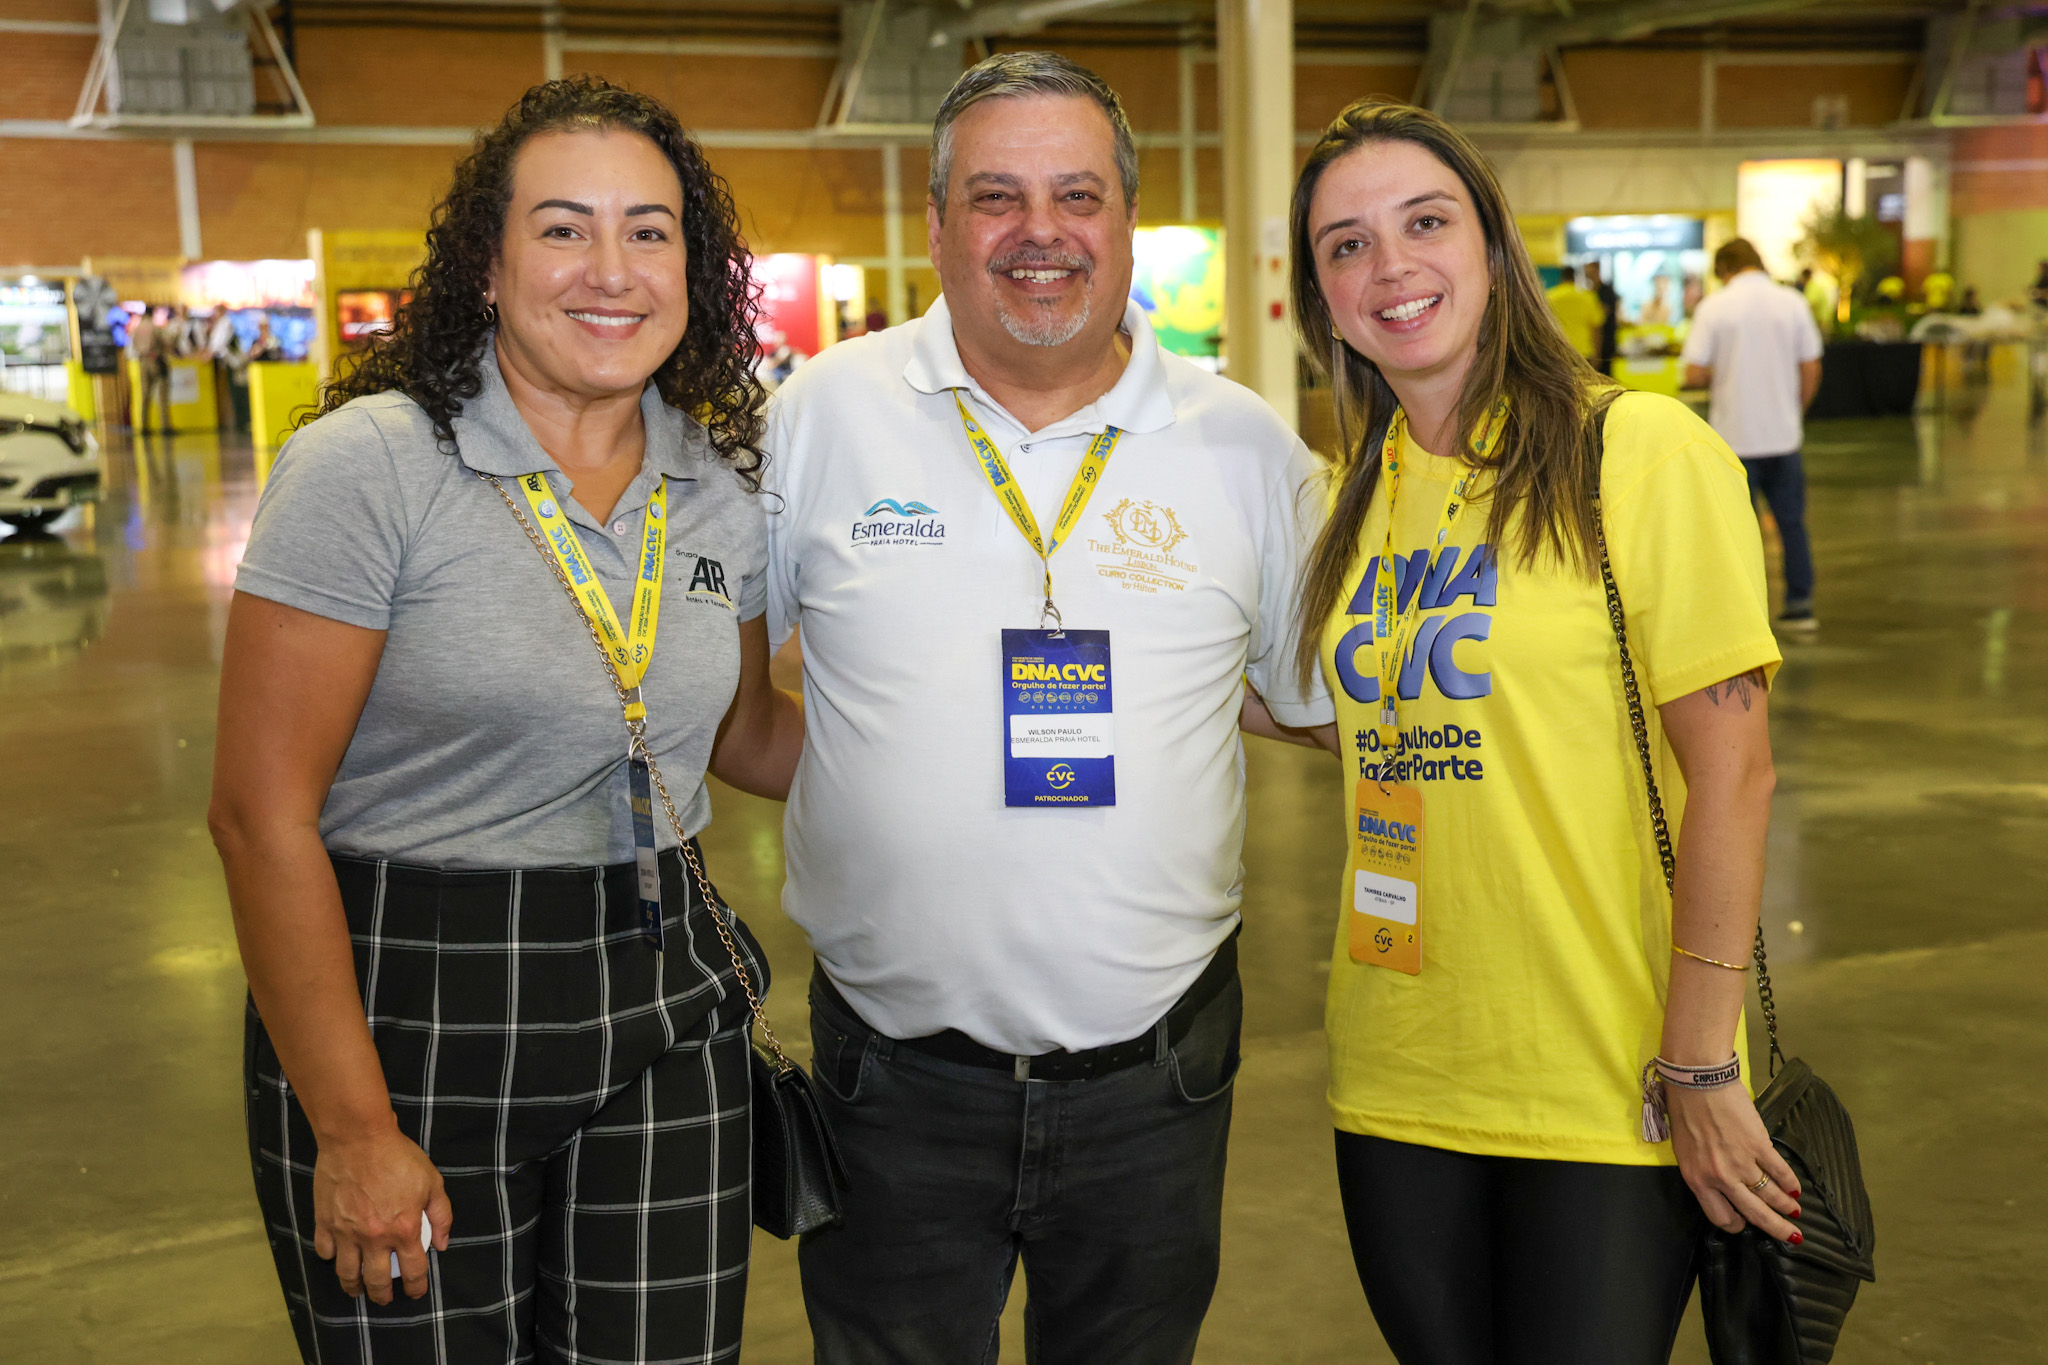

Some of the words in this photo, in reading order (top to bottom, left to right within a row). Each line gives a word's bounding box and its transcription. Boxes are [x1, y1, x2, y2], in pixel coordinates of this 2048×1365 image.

[1095, 437, 1112, 461] CVC
[1084, 466, 1095, 483] CVC
[852, 519, 945, 540] Esmeralda
[569, 538, 579, 553] fazer
[893, 538, 918, 546] HOTEL
[1087, 539, 1111, 553] THE
[1112, 543, 1164, 563] EMERALD
[1165, 554, 1198, 573] HOUSE
[579, 559, 594, 580] Orgulho
[689, 556, 731, 601] AR
[1098, 569, 1127, 579] CURIO
[1129, 573, 1184, 591] COLLECTION
[1122, 581, 1132, 590] by
[1133, 582, 1158, 594] Hilton
[1345, 544, 1498, 615] DNA
[615, 646, 628, 666] CVC
[634, 643, 643, 663] CVC
[1335, 612, 1493, 703] CVC
[1012, 681, 1045, 690] Orgulho
[1047, 681, 1057, 689] de
[1082, 683, 1106, 691] parte!
[1011, 736, 1054, 744] ESMERALDA
[1355, 724, 1482, 756] #OgulhoDe
[1046, 771, 1075, 781] CVC
[1358, 833, 1378, 844] Orgulho
[1386, 840, 1399, 848] fazer
[1383, 892, 1406, 902] CARVALHO
[1374, 934, 1393, 947] CVC
[1408, 934, 1413, 943] 2
